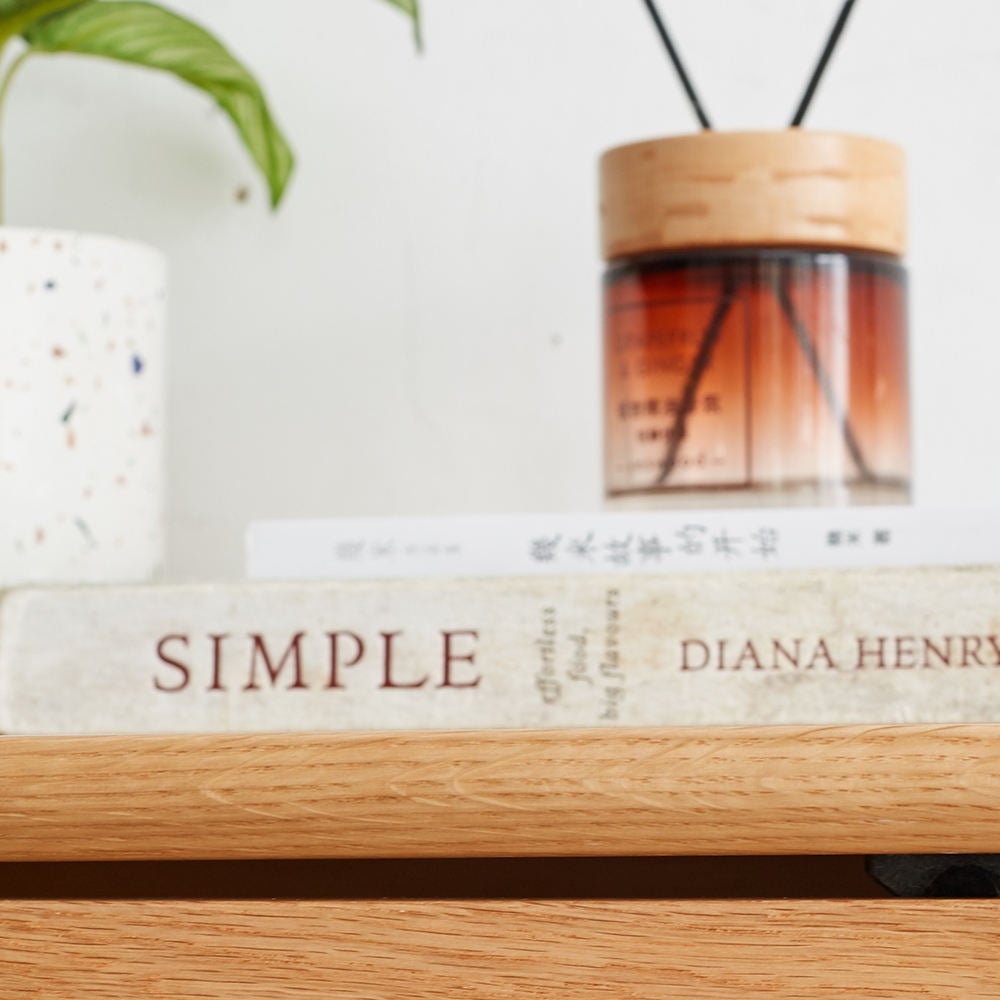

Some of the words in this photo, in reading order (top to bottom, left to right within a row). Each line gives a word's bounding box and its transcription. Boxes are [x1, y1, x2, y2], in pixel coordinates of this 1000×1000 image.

[152, 629, 481, 693] SIMPLE
[534, 605, 563, 704] effortless
[598, 588, 626, 682] flavours
[680, 639, 836, 672] DIANA
[598, 687, 626, 720] big
